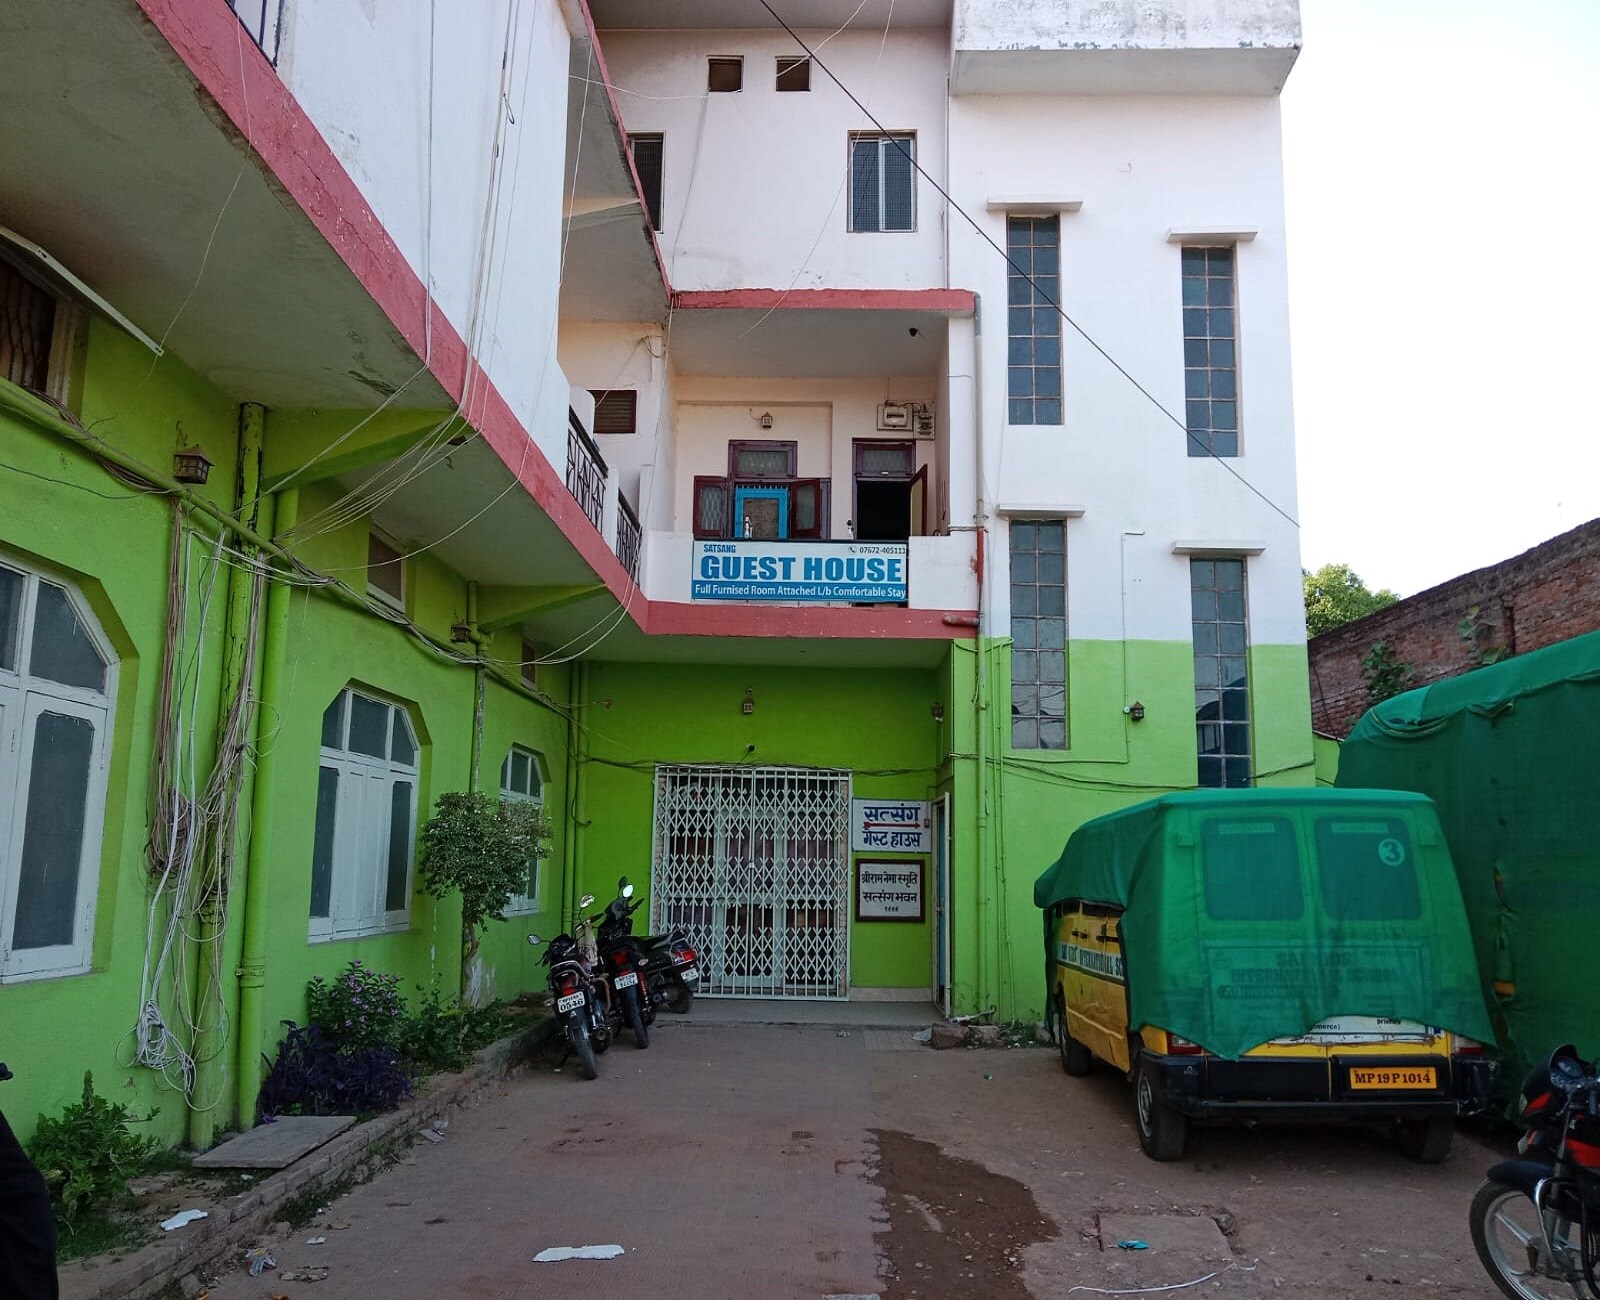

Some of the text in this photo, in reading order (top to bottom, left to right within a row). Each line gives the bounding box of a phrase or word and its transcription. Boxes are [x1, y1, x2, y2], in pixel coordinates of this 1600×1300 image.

[703, 544, 736, 553] SATSANG
[700, 555, 902, 582] GUEST HOUSE
[695, 584, 711, 594] Full
[712, 584, 749, 595] Furnised
[751, 585, 776, 595] Room
[777, 585, 816, 596] Attached
[833, 586, 887, 597] Comfortable
[887, 587, 906, 599] Stay
[863, 803, 921, 822] सत्संग
[891, 832, 922, 848] हाउस
[863, 889, 918, 903] सत्संग भवन
[1355, 1073, 1431, 1084] MP 19 P 1014
